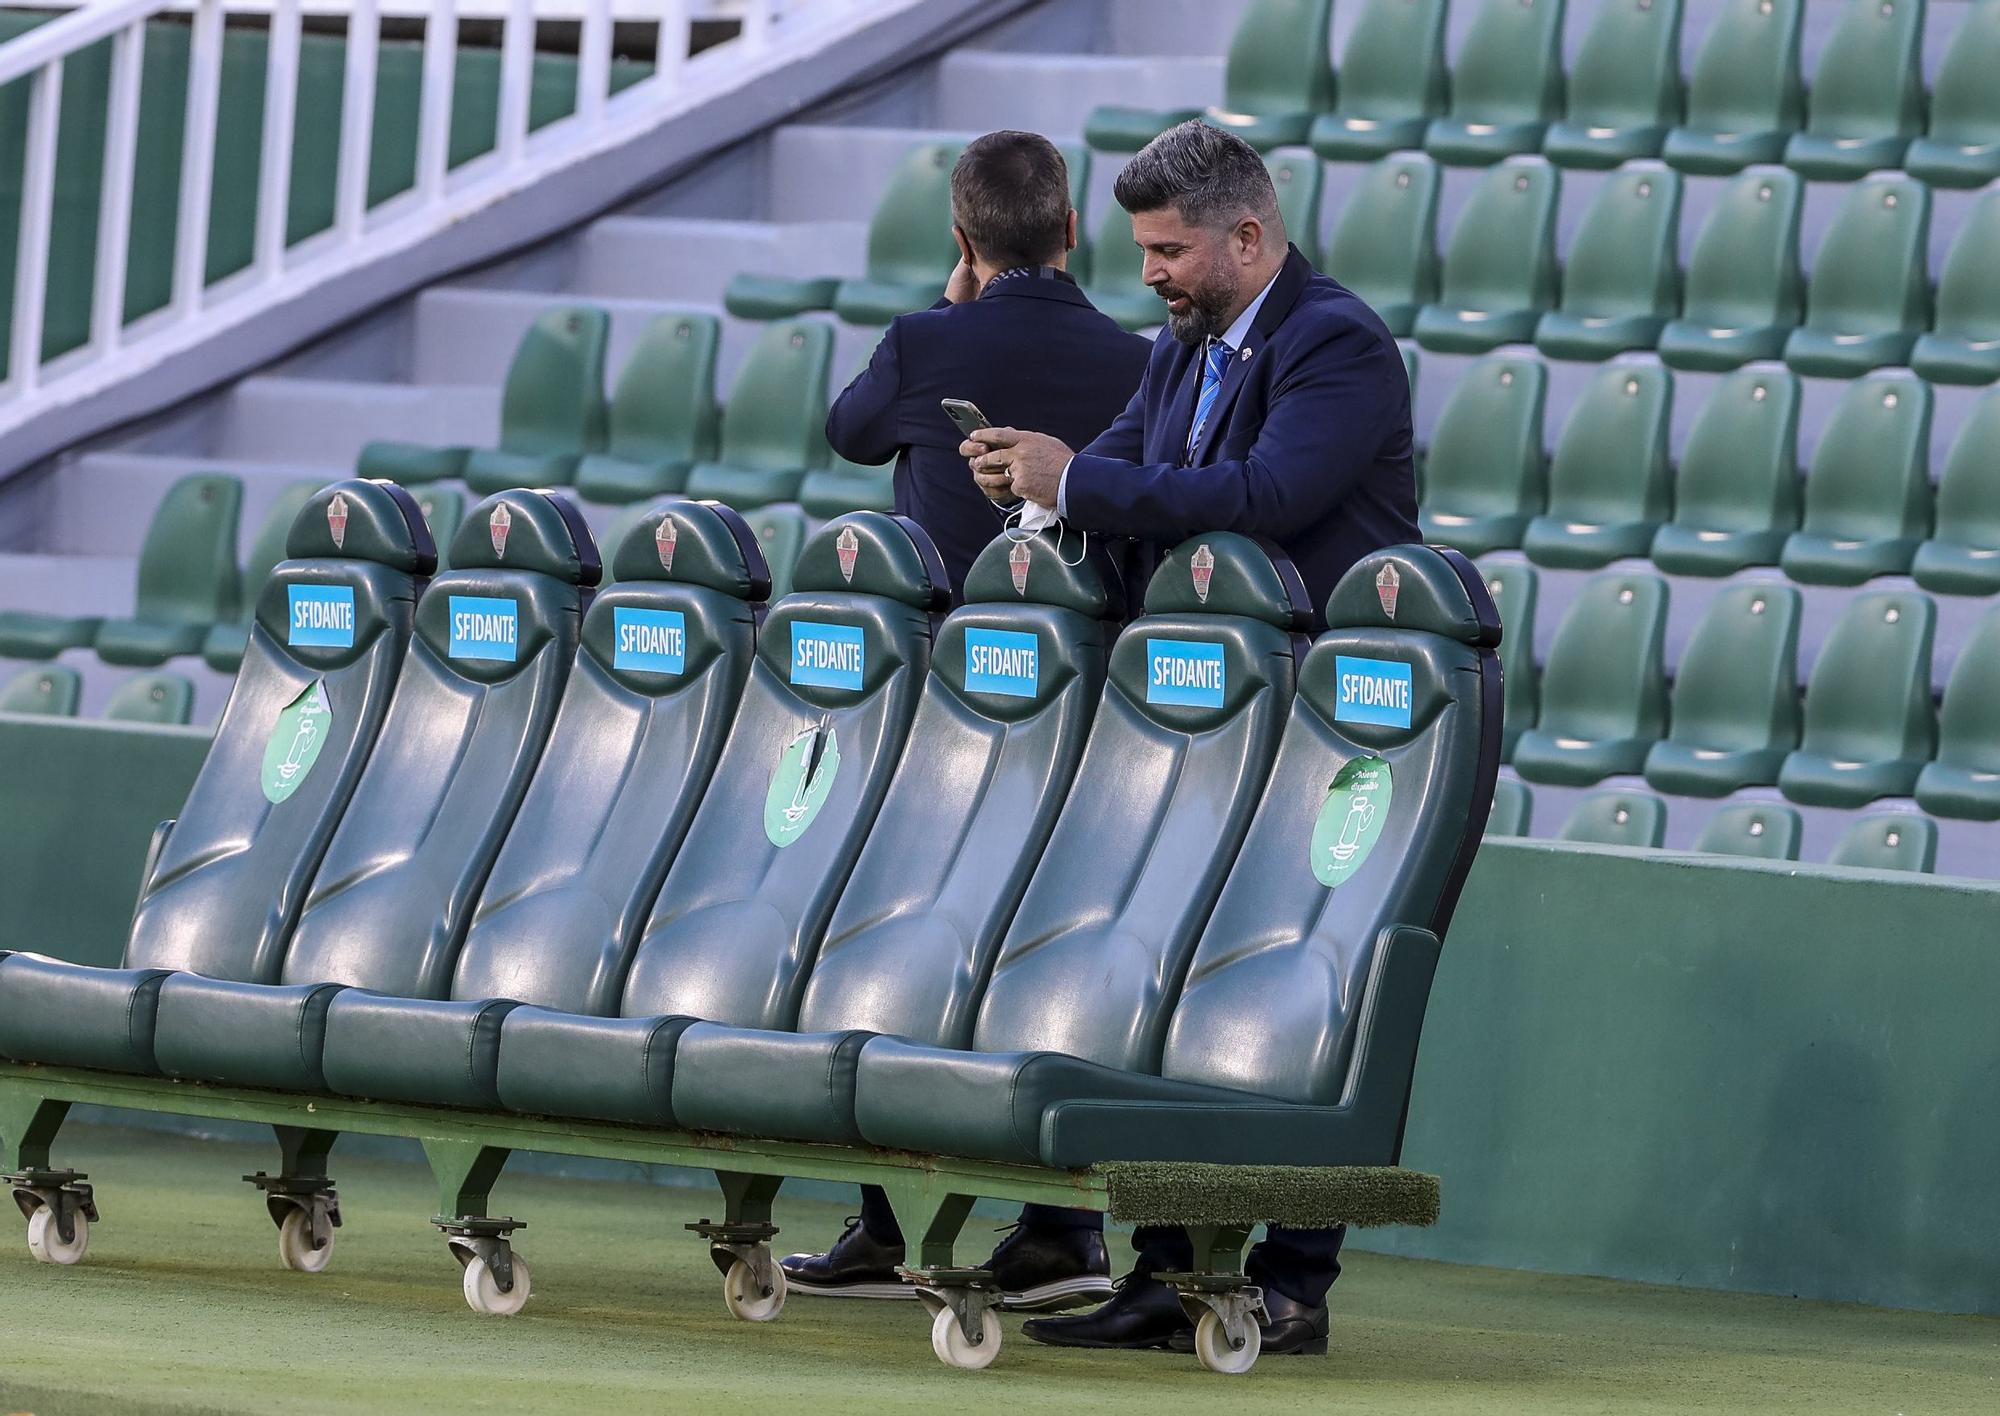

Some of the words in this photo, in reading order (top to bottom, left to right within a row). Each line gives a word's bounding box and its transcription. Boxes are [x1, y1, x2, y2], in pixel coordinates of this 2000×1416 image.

[294, 600, 352, 630] SFIDANTE
[455, 612, 515, 644] SFIDANTE
[620, 623, 682, 656] SFIDANTE
[797, 638, 861, 672] SFIDANTE
[971, 645, 1035, 679] SFIDANTE
[1153, 656, 1221, 690] SFIDANTE
[1342, 673, 1409, 710] SFIDANTE
